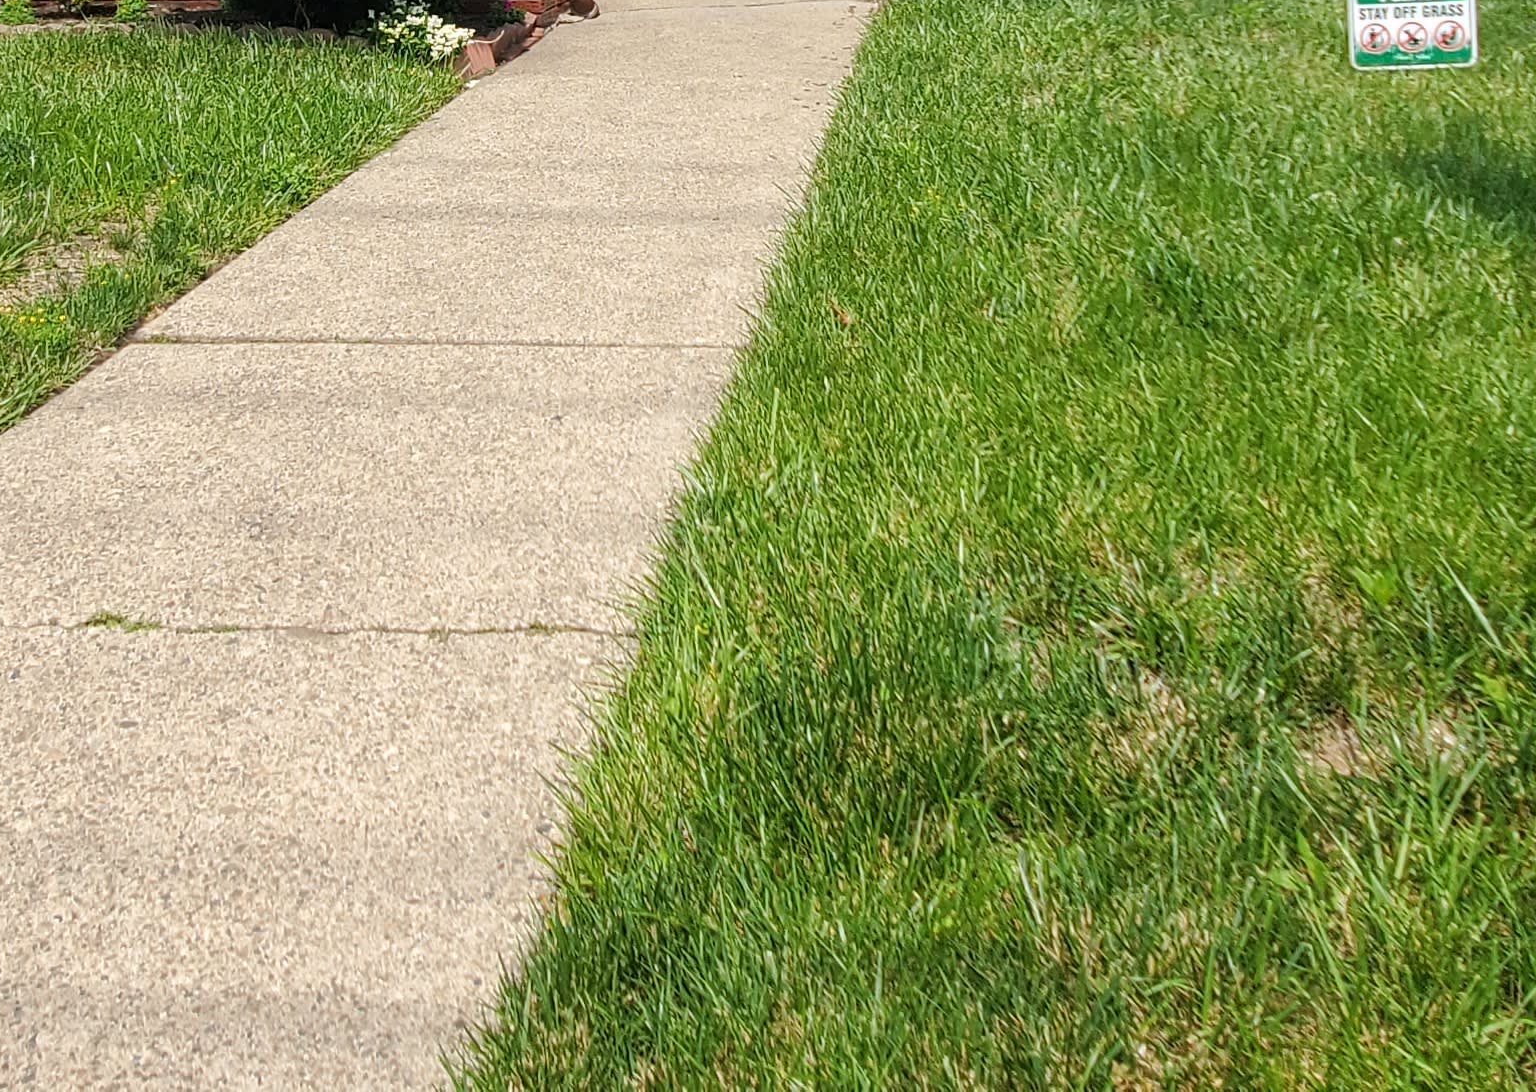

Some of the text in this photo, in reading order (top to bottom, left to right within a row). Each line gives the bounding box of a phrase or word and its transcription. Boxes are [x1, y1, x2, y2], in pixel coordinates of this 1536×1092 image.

[1359, 3, 1464, 21] STAY OFF GRASS
